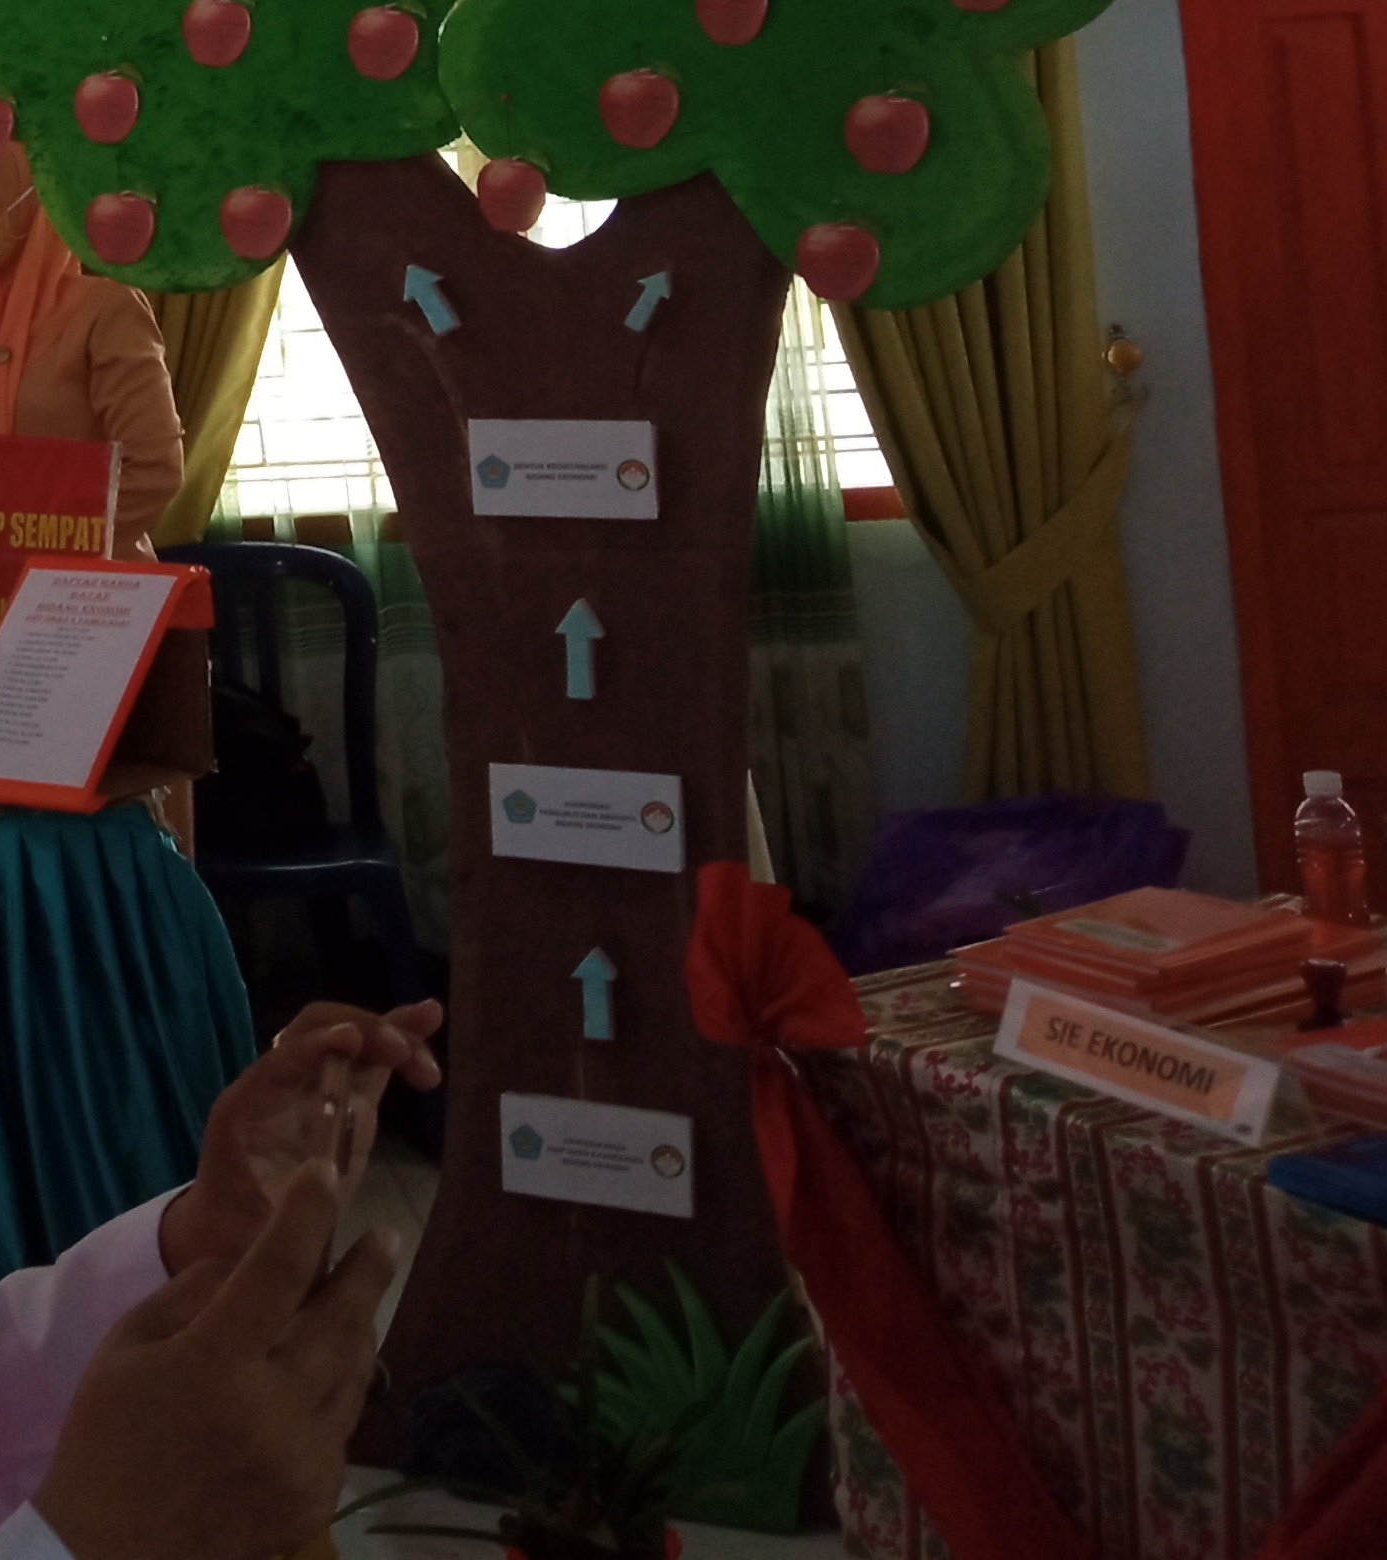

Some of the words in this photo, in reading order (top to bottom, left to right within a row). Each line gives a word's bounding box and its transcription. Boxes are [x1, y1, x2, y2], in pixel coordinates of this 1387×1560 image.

[9, 510, 106, 553] SEMPAT
[1045, 1016, 1084, 1048] SIE
[1086, 1030, 1216, 1094] EKONOMI
